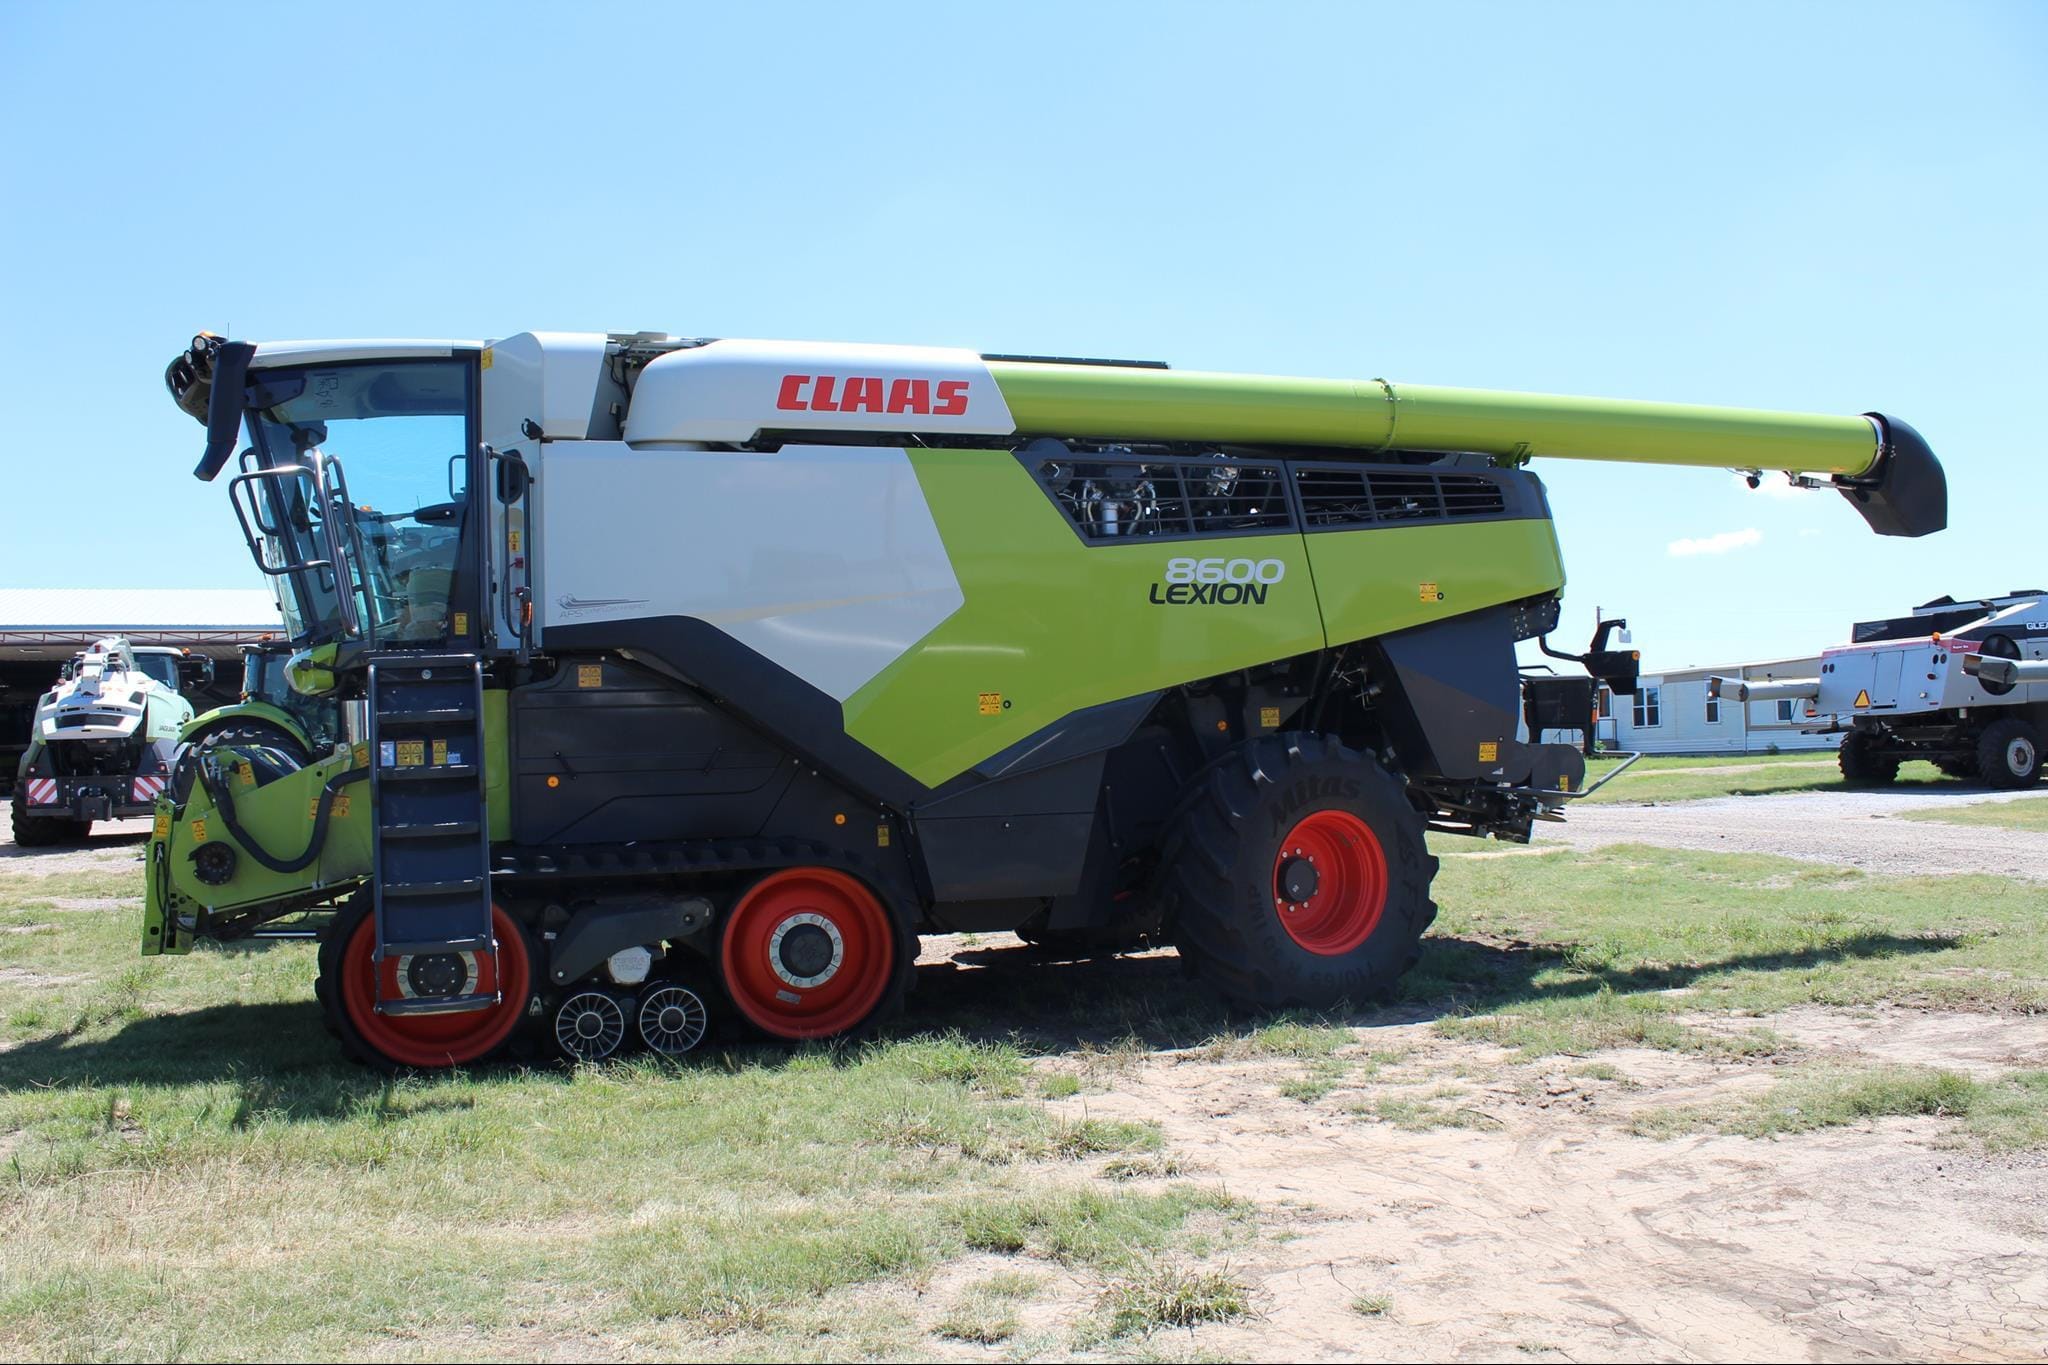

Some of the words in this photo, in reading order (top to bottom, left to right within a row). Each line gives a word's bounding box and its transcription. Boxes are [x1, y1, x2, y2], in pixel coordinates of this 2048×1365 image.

[776, 374, 970, 416] CLAAS
[1164, 557, 1286, 585] 8600
[1149, 582, 1269, 605] LEXION
[1268, 775, 1361, 838] Mitas
